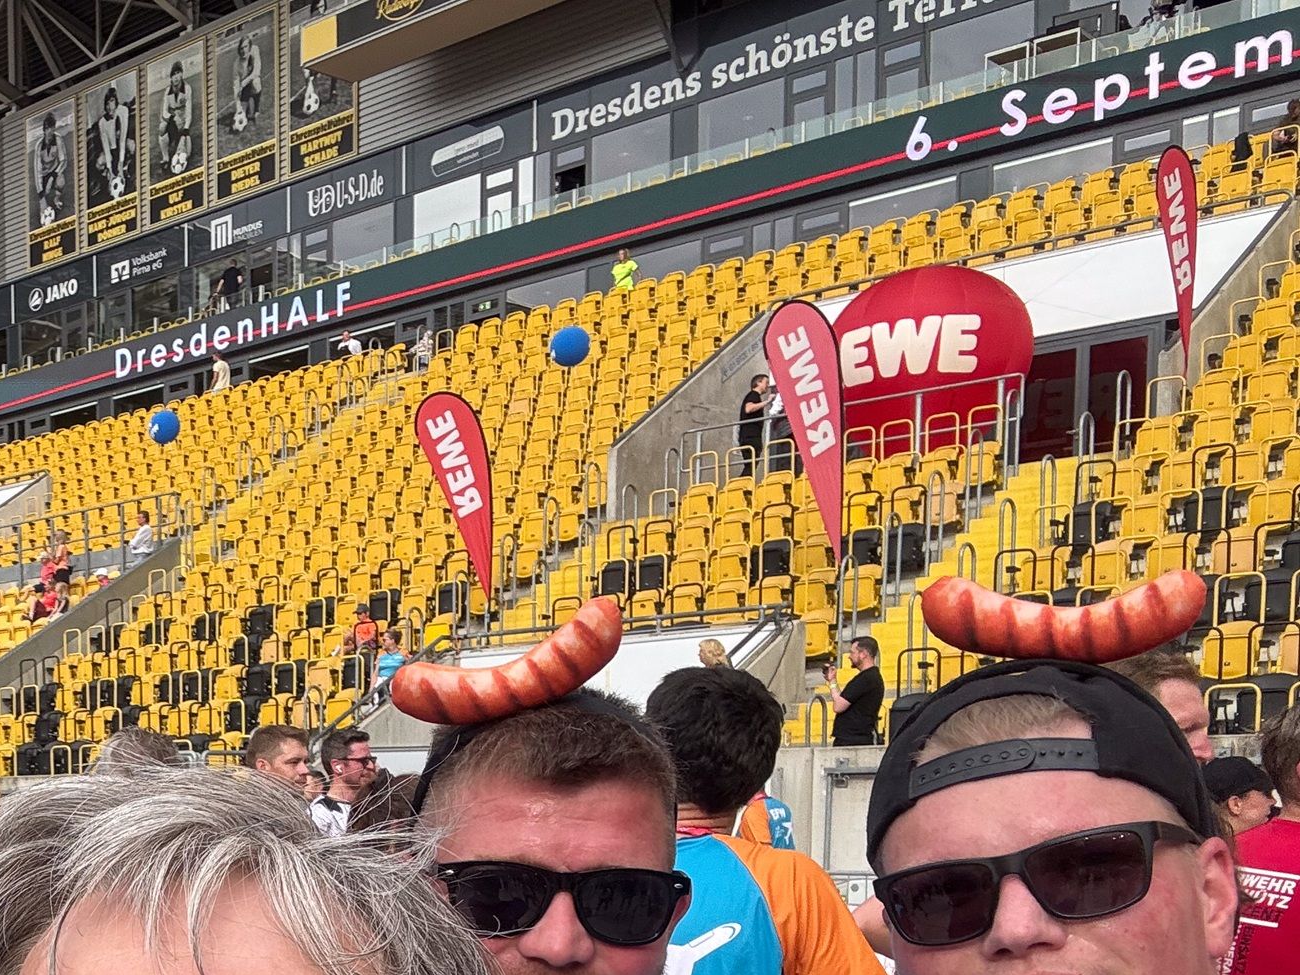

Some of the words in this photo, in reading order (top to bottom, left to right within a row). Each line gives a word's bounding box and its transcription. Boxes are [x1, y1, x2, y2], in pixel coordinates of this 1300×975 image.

[551, 71, 702, 142] Dresdens
[710, 13, 876, 91] schönste
[887, 0, 996, 32] Ter
[905, 115, 959, 162] 6.
[999, 30, 1293, 137] Septem
[45, 279, 78, 304] JAKO
[131, 248, 168, 266] Volksbank
[132, 262, 150, 276] Pirna
[152, 259, 163, 270] eG
[115, 281, 351, 378] DresdenHALF
[840, 314, 982, 388] EWE
